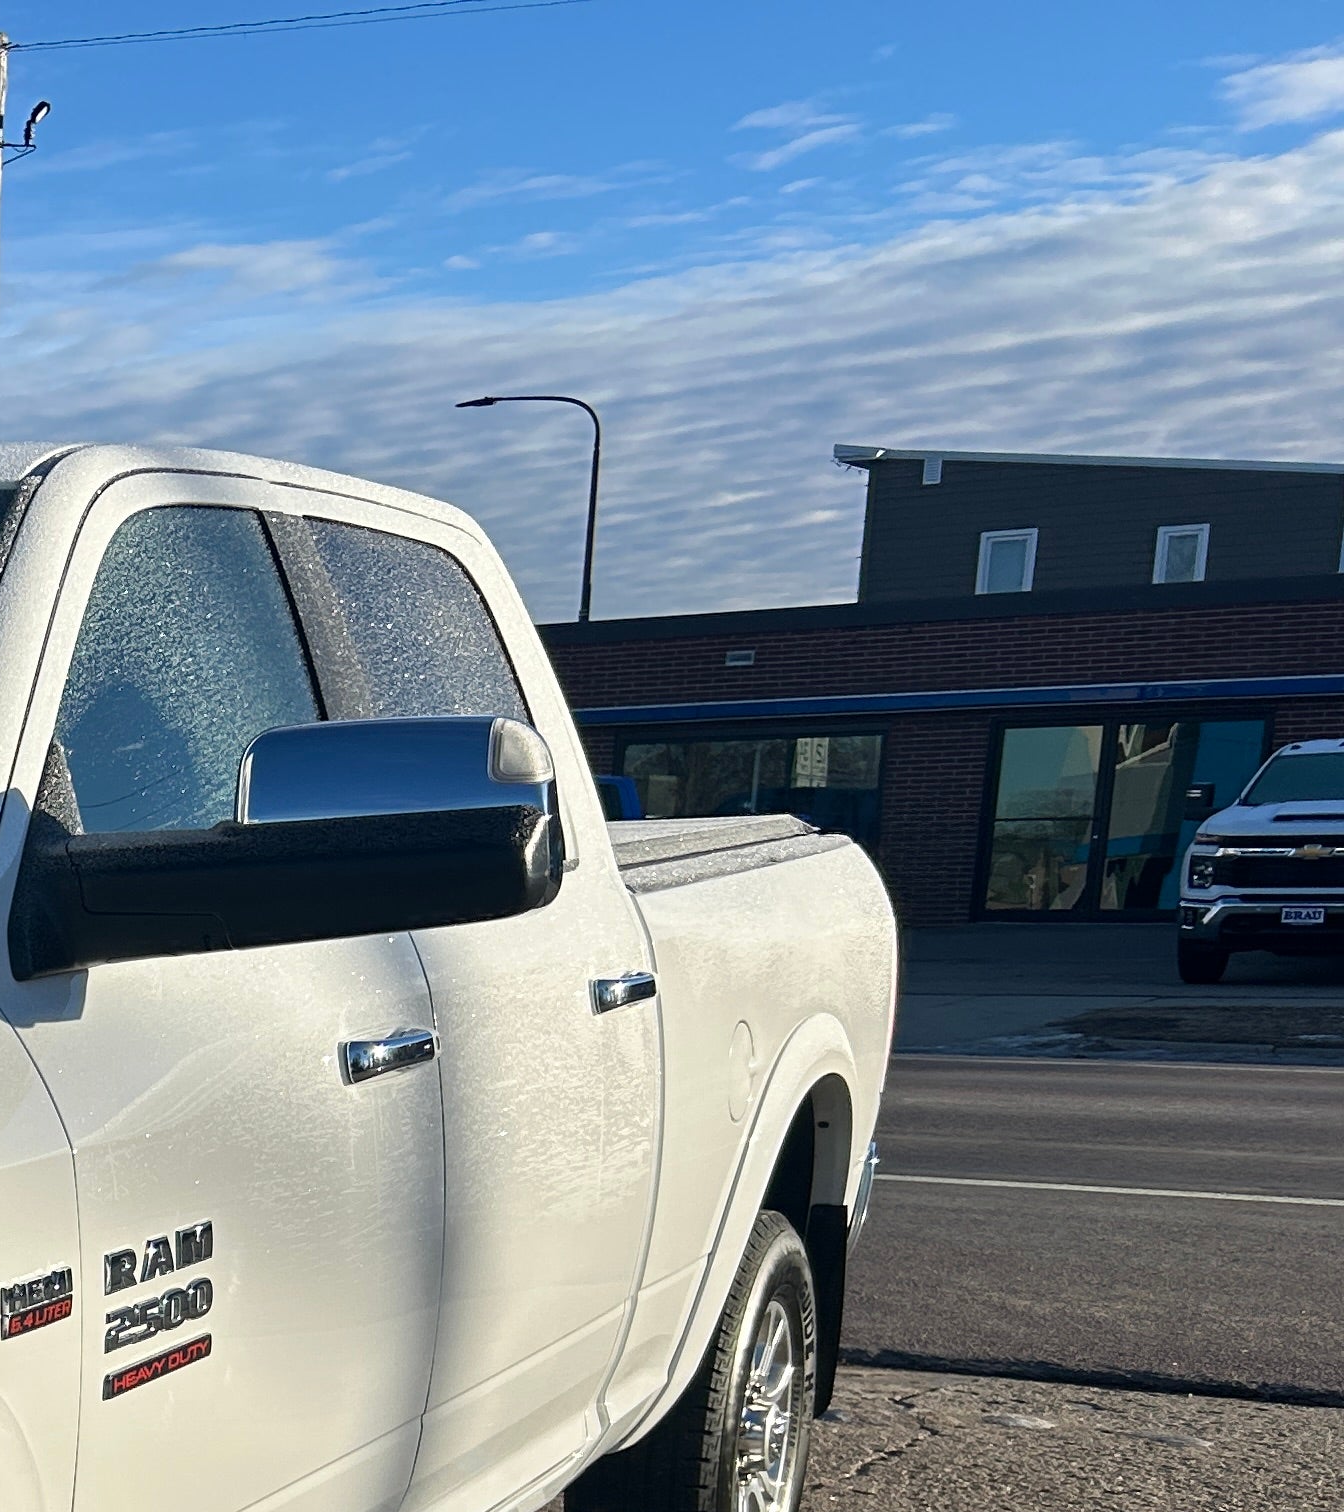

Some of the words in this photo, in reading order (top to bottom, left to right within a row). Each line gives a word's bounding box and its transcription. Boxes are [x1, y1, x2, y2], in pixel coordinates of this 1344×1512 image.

[104, 1219, 213, 1296] RAM
[1, 1267, 73, 1314] HEMI
[10, 1311, 33, 1334] 6.4
[34, 1299, 71, 1326] LITER
[104, 1277, 213, 1354] 2500
[114, 1358, 166, 1393] HEAVY
[167, 1339, 210, 1369] DUTY
